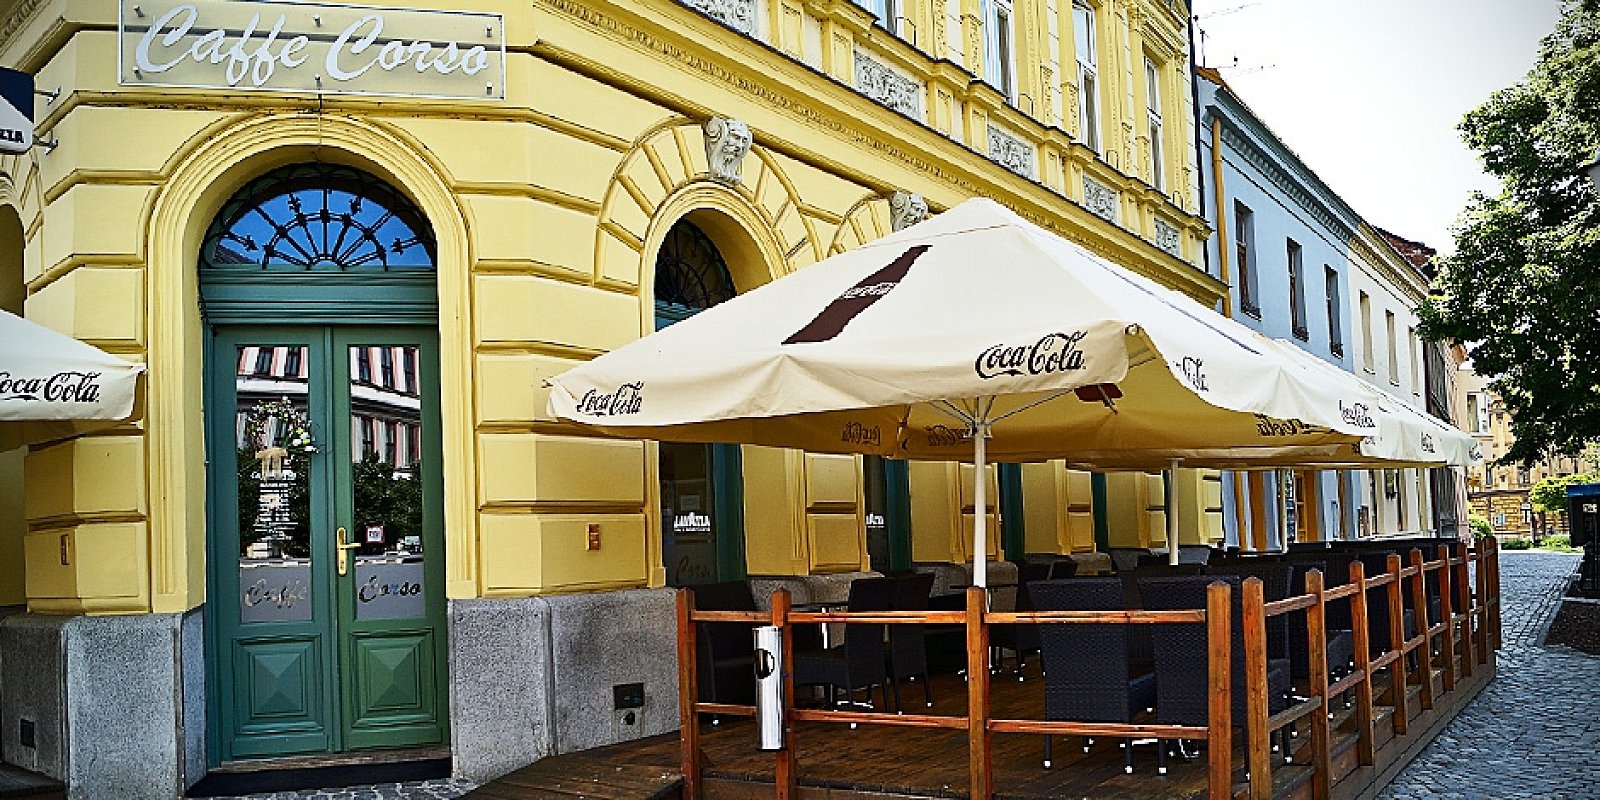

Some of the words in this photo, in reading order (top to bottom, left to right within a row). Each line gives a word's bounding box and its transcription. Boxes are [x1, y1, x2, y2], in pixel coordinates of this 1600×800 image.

[135, 3, 310, 87] Caffe
[326, 13, 490, 81] Corso
[974, 329, 1088, 380] Coca-Cola
[575, 380, 645, 417] Coca-Cola
[358, 574, 422, 604] Corso
